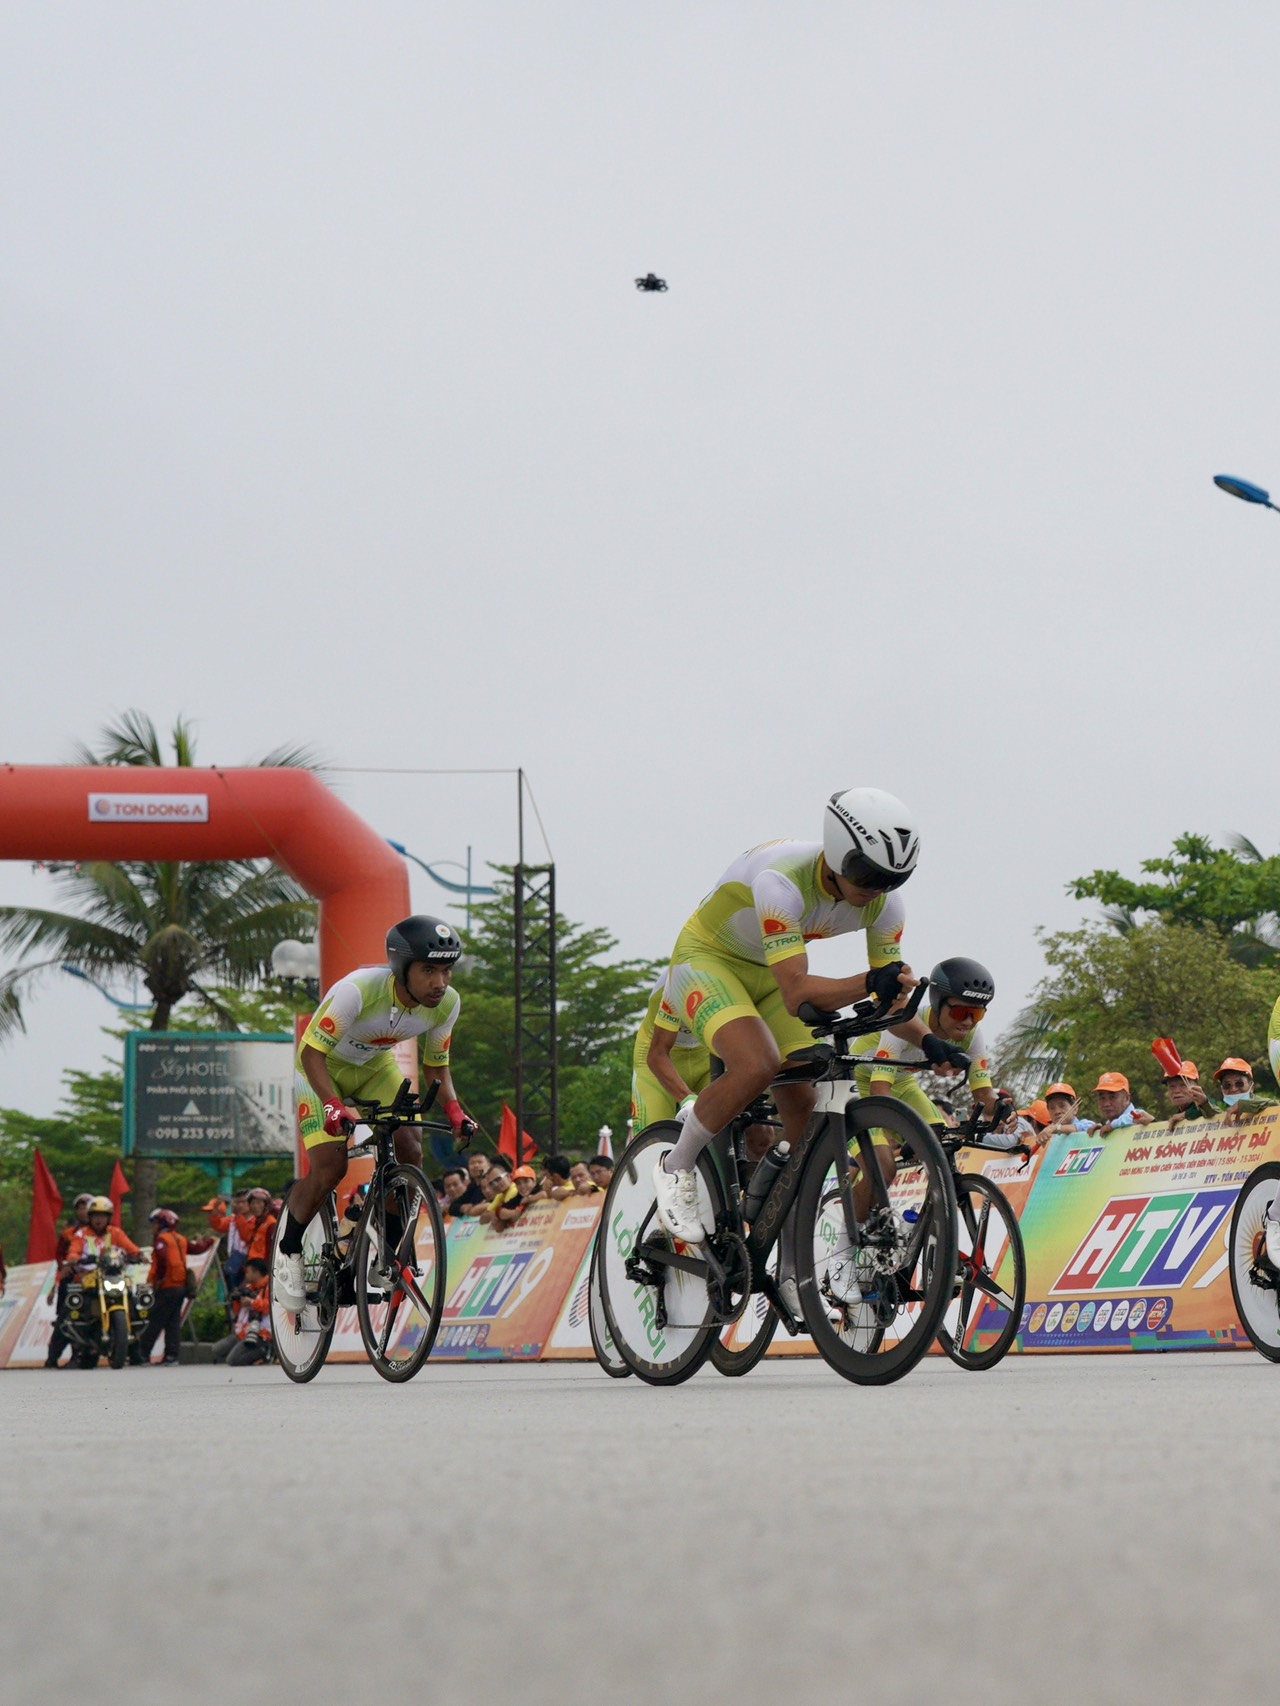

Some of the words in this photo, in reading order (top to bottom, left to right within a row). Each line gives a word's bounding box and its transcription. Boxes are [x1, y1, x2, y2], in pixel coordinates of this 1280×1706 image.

[114, 804, 145, 816] TON
[147, 804, 190, 816] DONG
[192, 804, 203, 816] A
[427, 951, 460, 959] GIANT
[961, 990, 992, 1000] GIANT
[186, 1062, 231, 1077] HOTEL
[1124, 1148, 1151, 1163] NON
[1154, 1139, 1188, 1159] SÔNG
[1216, 1131, 1247, 1154] MỘT
[1056, 1147, 1104, 1174] HTV
[613, 1210, 641, 1258] LỘ
